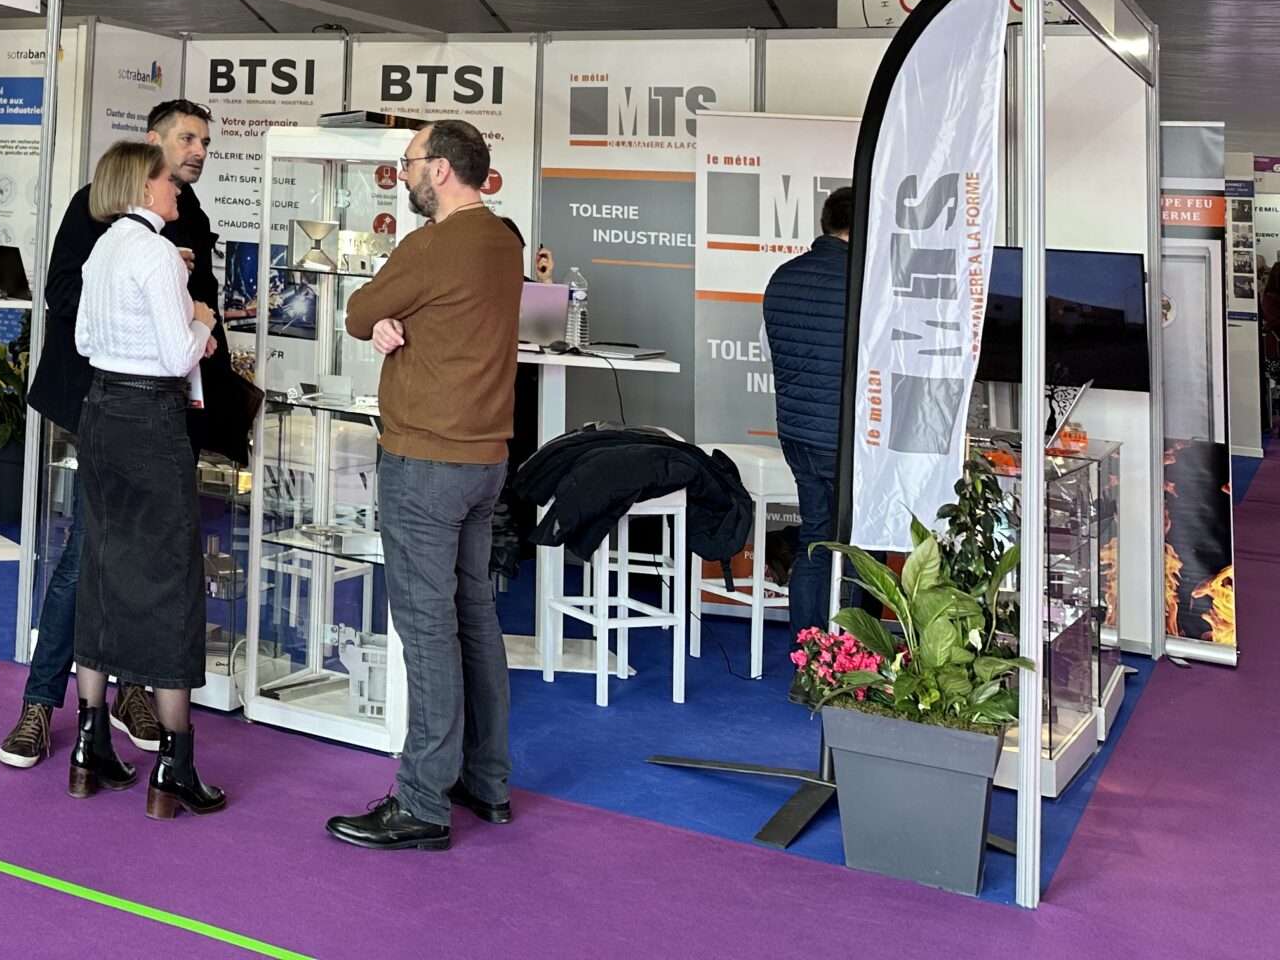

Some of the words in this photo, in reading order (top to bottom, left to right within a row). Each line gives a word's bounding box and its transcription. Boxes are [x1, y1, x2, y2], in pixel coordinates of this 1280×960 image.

[7, 49, 46, 59] sotraban
[118, 68, 151, 82] sotraban
[209, 58, 315, 95] BTSI
[582, 73, 609, 81] métal
[380, 64, 504, 104] BTSI
[221, 117, 246, 126] Votre
[248, 118, 298, 128] partenaire
[221, 128, 242, 138] inox,
[244, 129, 256, 137] alu
[209, 151, 243, 160] TÔLERIE
[707, 154, 719, 165] le
[723, 153, 761, 167] métal
[218, 173, 237, 182] BÂTI
[239, 175, 257, 183] SUR
[259, 177, 297, 186] SURE
[966, 171, 980, 227] FORME
[1161, 198, 1182, 208] PE
[1187, 198, 1213, 209] FEU
[569, 203, 639, 219] TOLERIE
[1162, 211, 1201, 221] ERME
[593, 229, 696, 247] INDUSTRIEL
[967, 231, 981, 250] LA
[968, 254, 982, 264] A
[870, 369, 882, 424] métal
[866, 426, 881, 447] le
